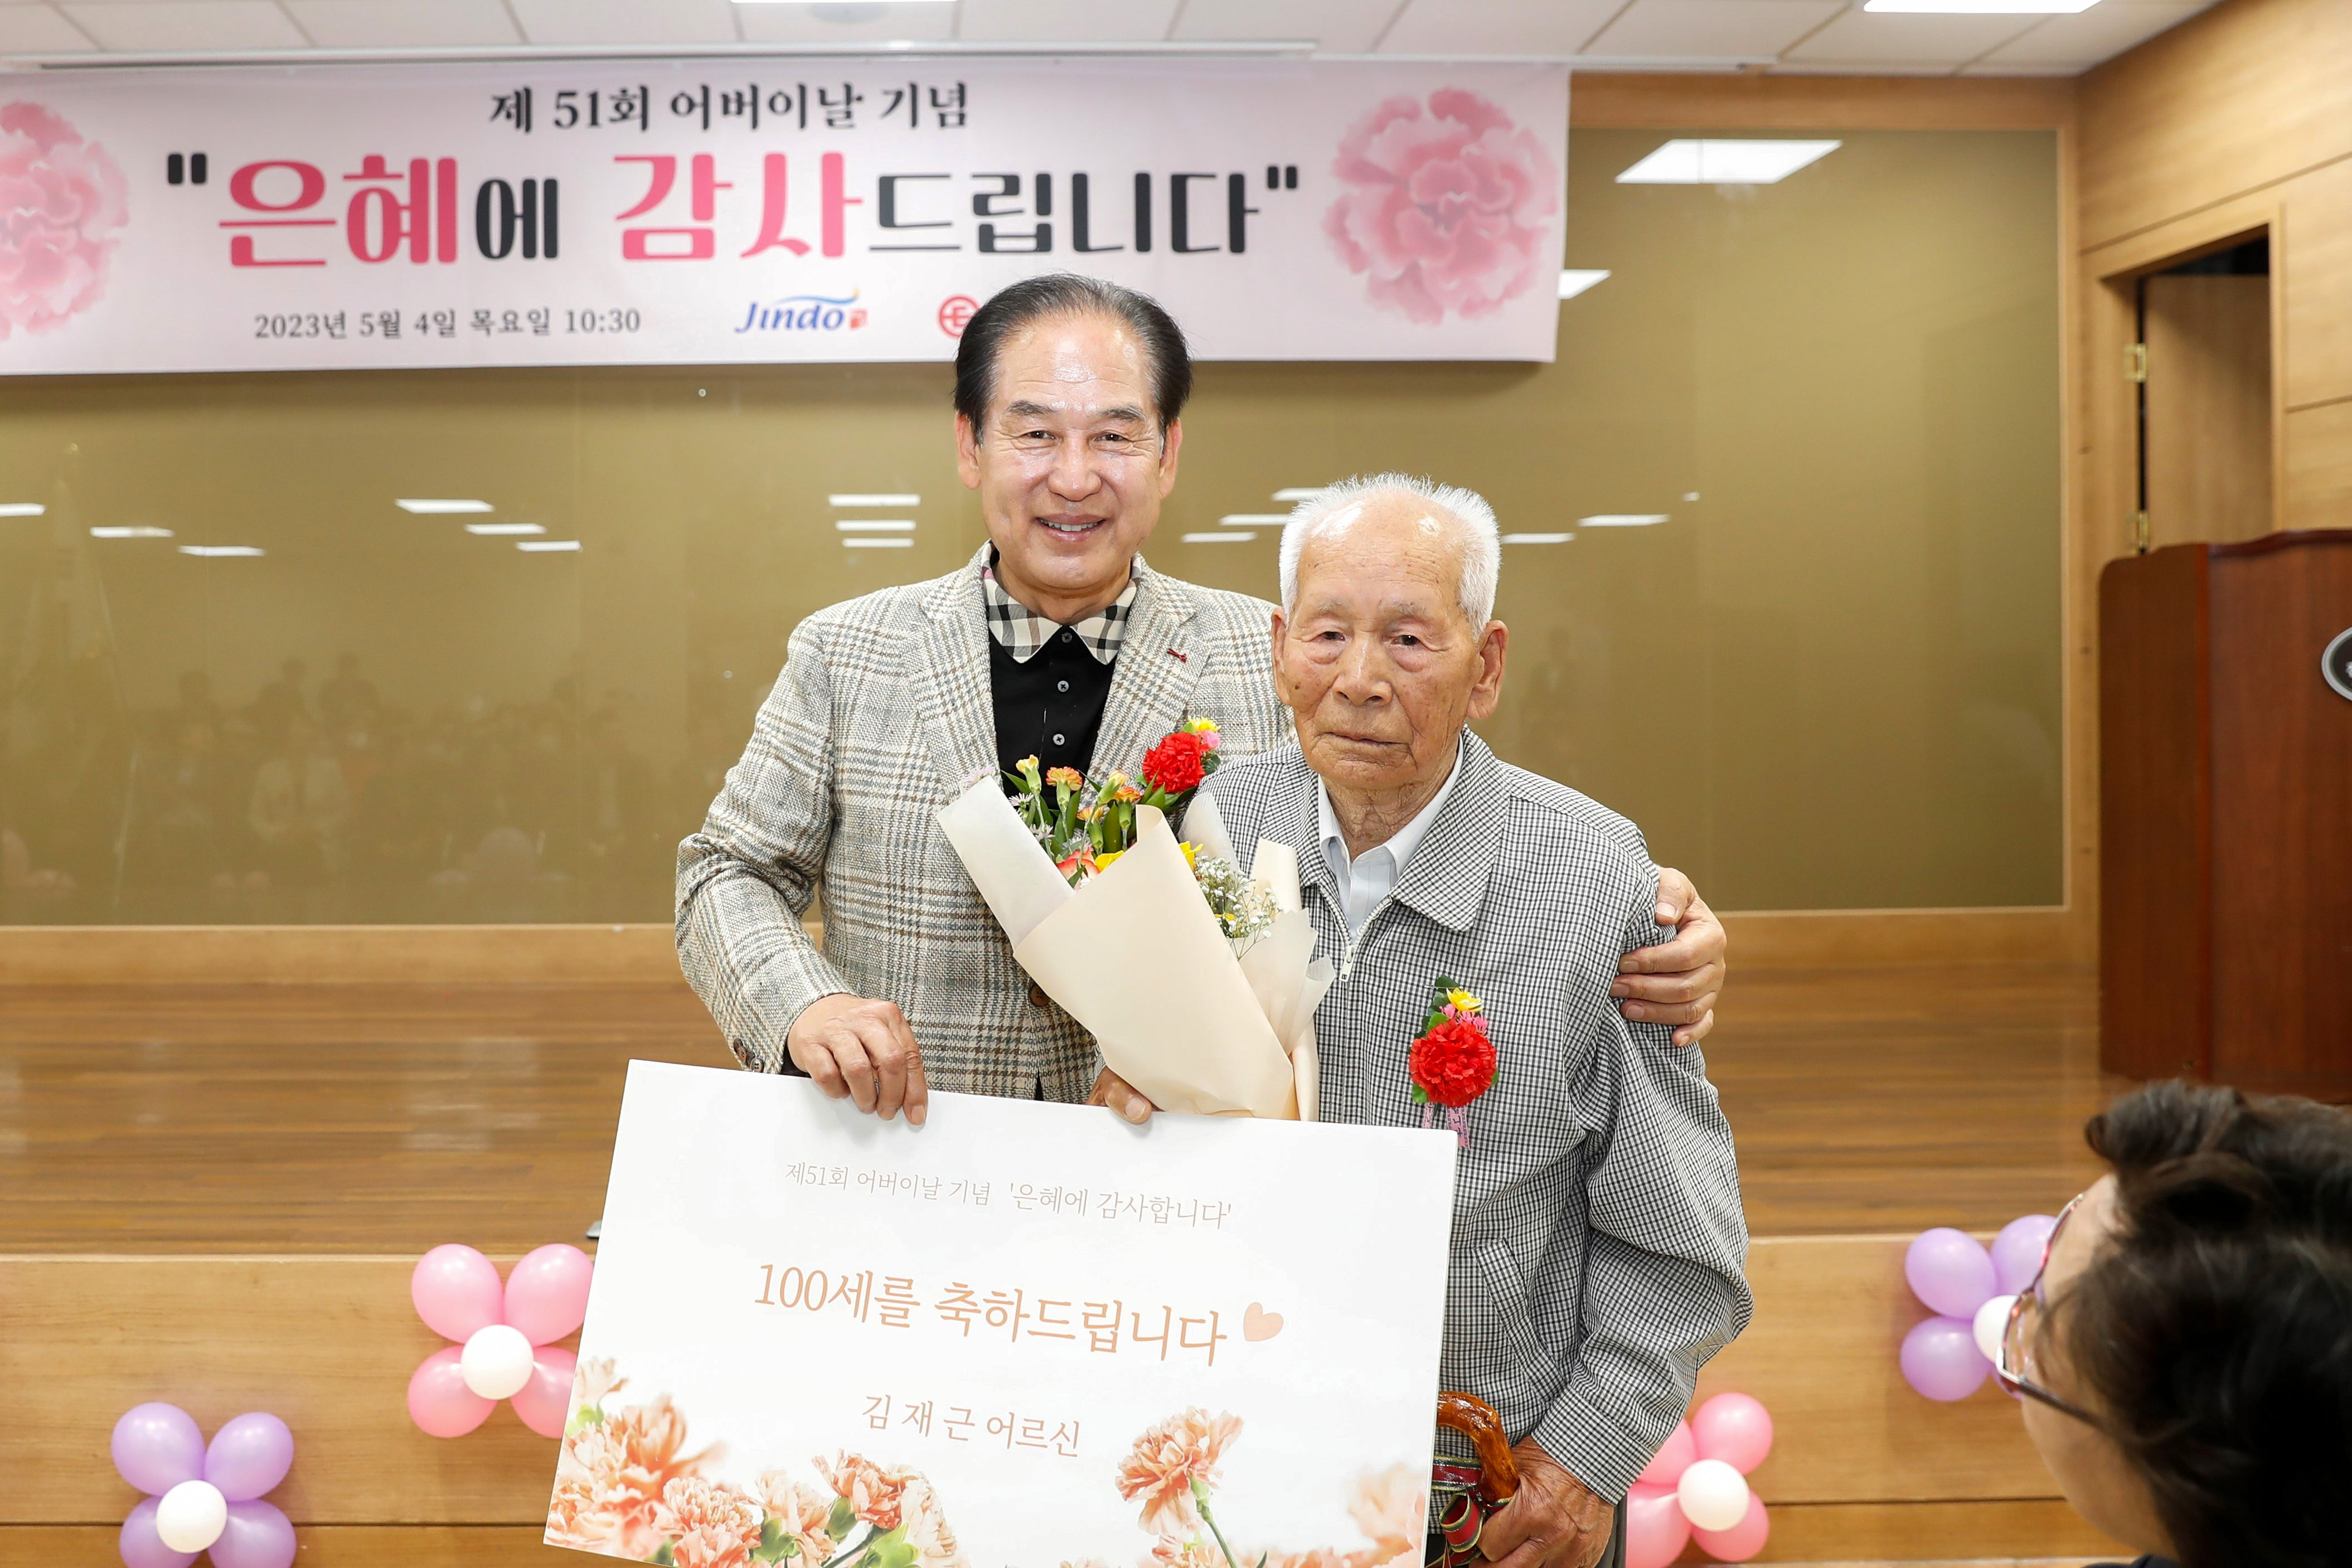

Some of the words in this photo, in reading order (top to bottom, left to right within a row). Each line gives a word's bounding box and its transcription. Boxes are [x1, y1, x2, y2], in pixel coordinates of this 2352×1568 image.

[491, 86, 533, 134] 제
[554, 84, 650, 133] 51회
[670, 82, 864, 132] 어버이날
[882, 81, 967, 130] 기념
[255, 310, 346, 339] 2023년
[360, 309, 401, 339] 5월
[414, 309, 456, 338] 4일
[471, 307, 550, 336] 목요일
[567, 308, 641, 333] 10:30
[735, 301, 846, 333] Jindo
[784, 1161, 848, 1191] 제51회
[857, 1169, 943, 1201] 어버이날
[948, 1178, 991, 1206] 기념
[1010, 1182, 1089, 1217] '은혜에
[1096, 1191, 1232, 1230] 감사합니다'
[754, 1263, 922, 1329] 100세를
[934, 1281, 1228, 1367] 축하드립니다
[986, 1411, 1080, 1458] 어르신
